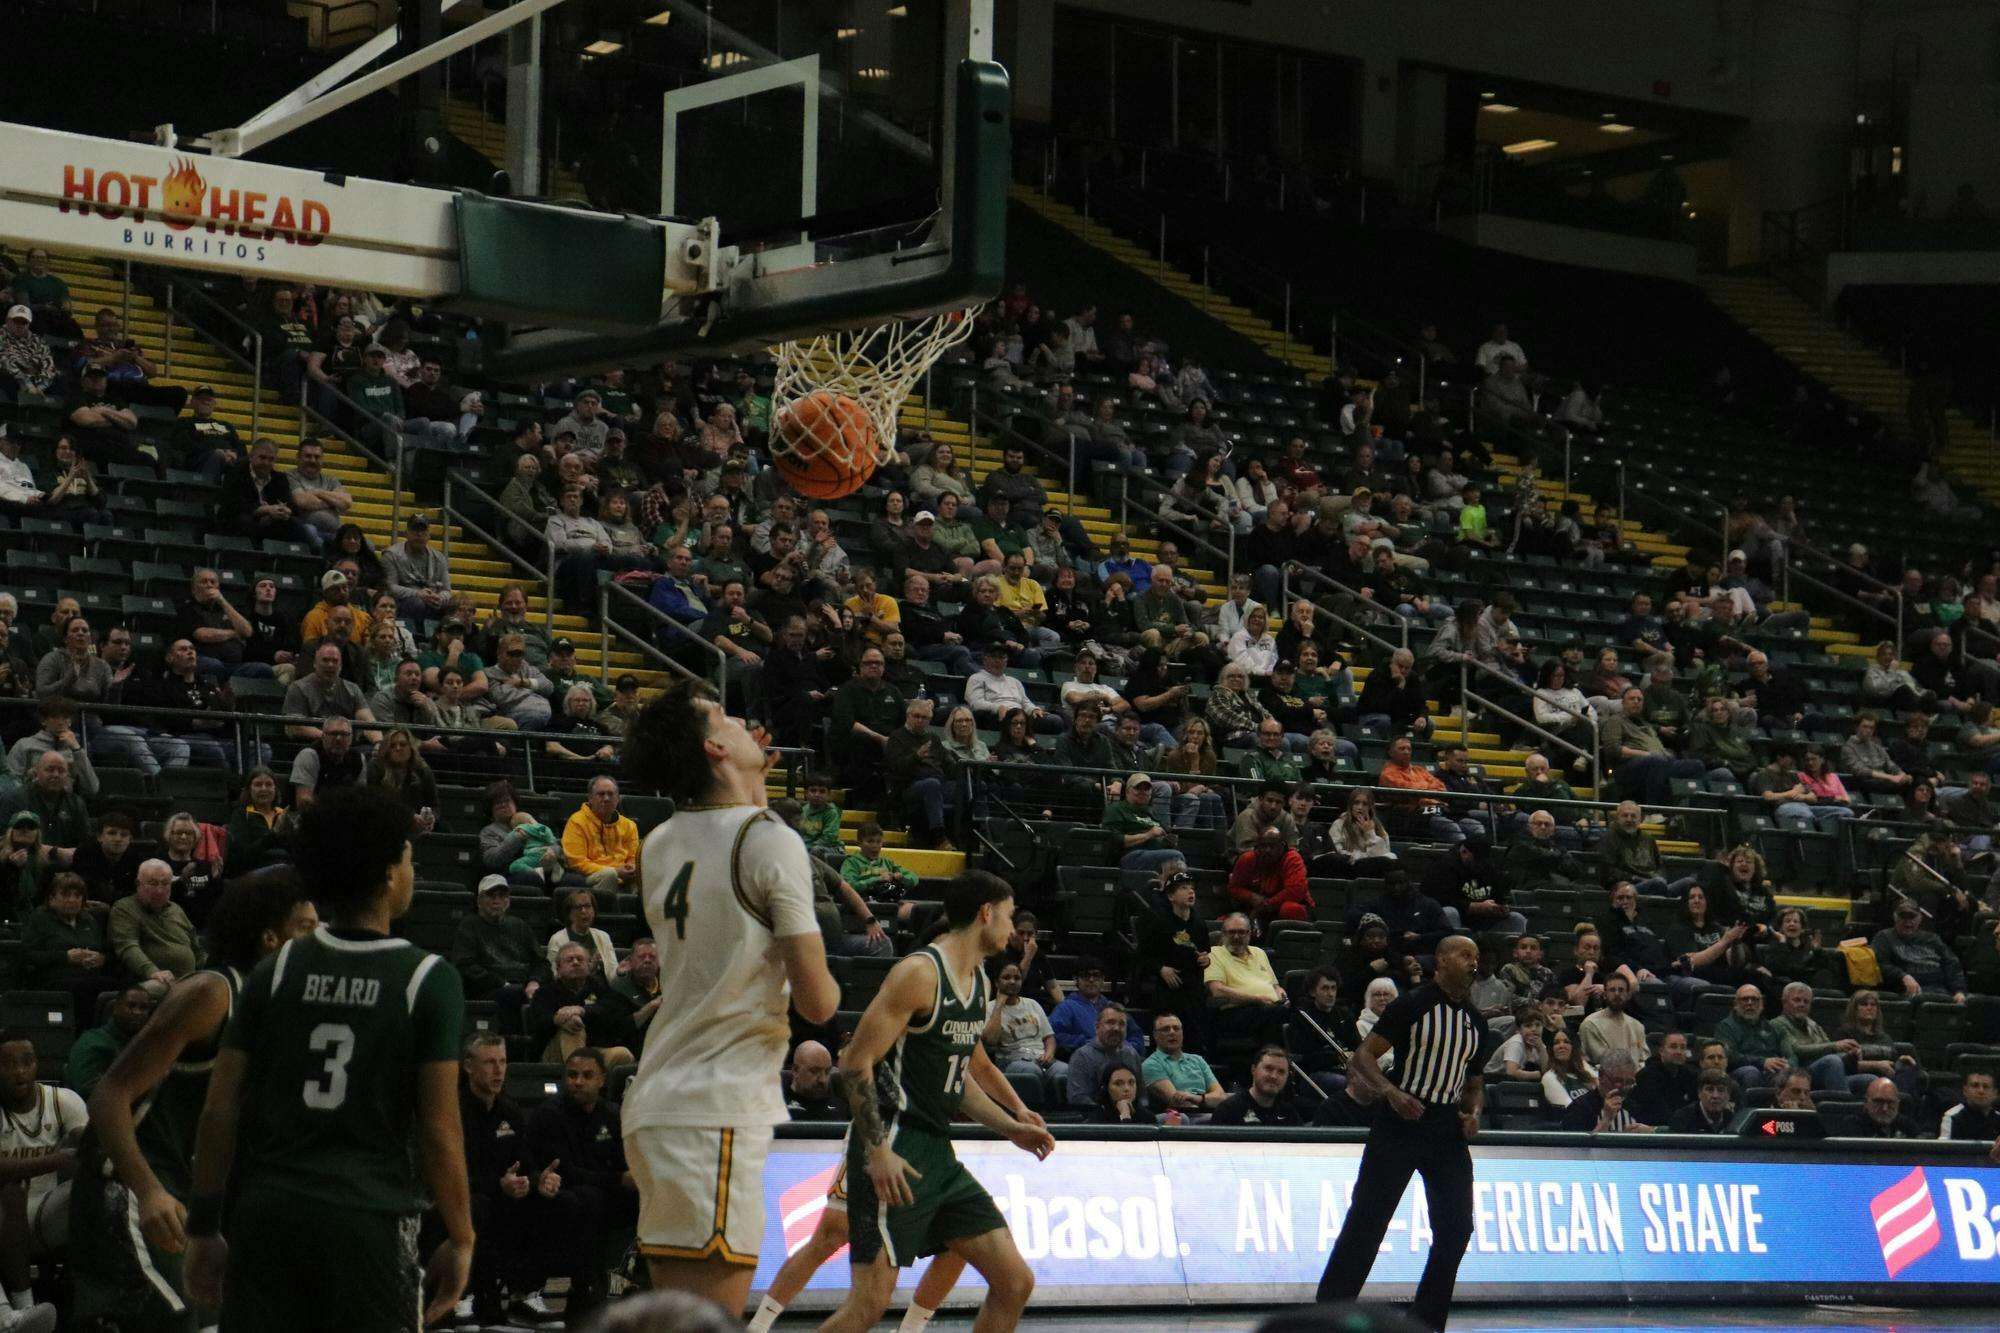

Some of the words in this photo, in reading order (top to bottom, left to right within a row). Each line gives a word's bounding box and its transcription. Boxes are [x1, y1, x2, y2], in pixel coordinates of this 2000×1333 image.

[59, 164, 158, 223] HOT
[205, 186, 331, 247] HEAD
[123, 228, 266, 261] BURRITOS
[663, 861, 695, 940] 4
[302, 973, 381, 1006] BEARD
[302, 1022, 356, 1109] 3
[951, 1033, 976, 1045] STATE
[1775, 1121, 1795, 1133] POSS
[1235, 1178, 1295, 1253] AN
[1639, 1182, 1768, 1254] SHAVE
[1942, 1178, 2000, 1260] B
